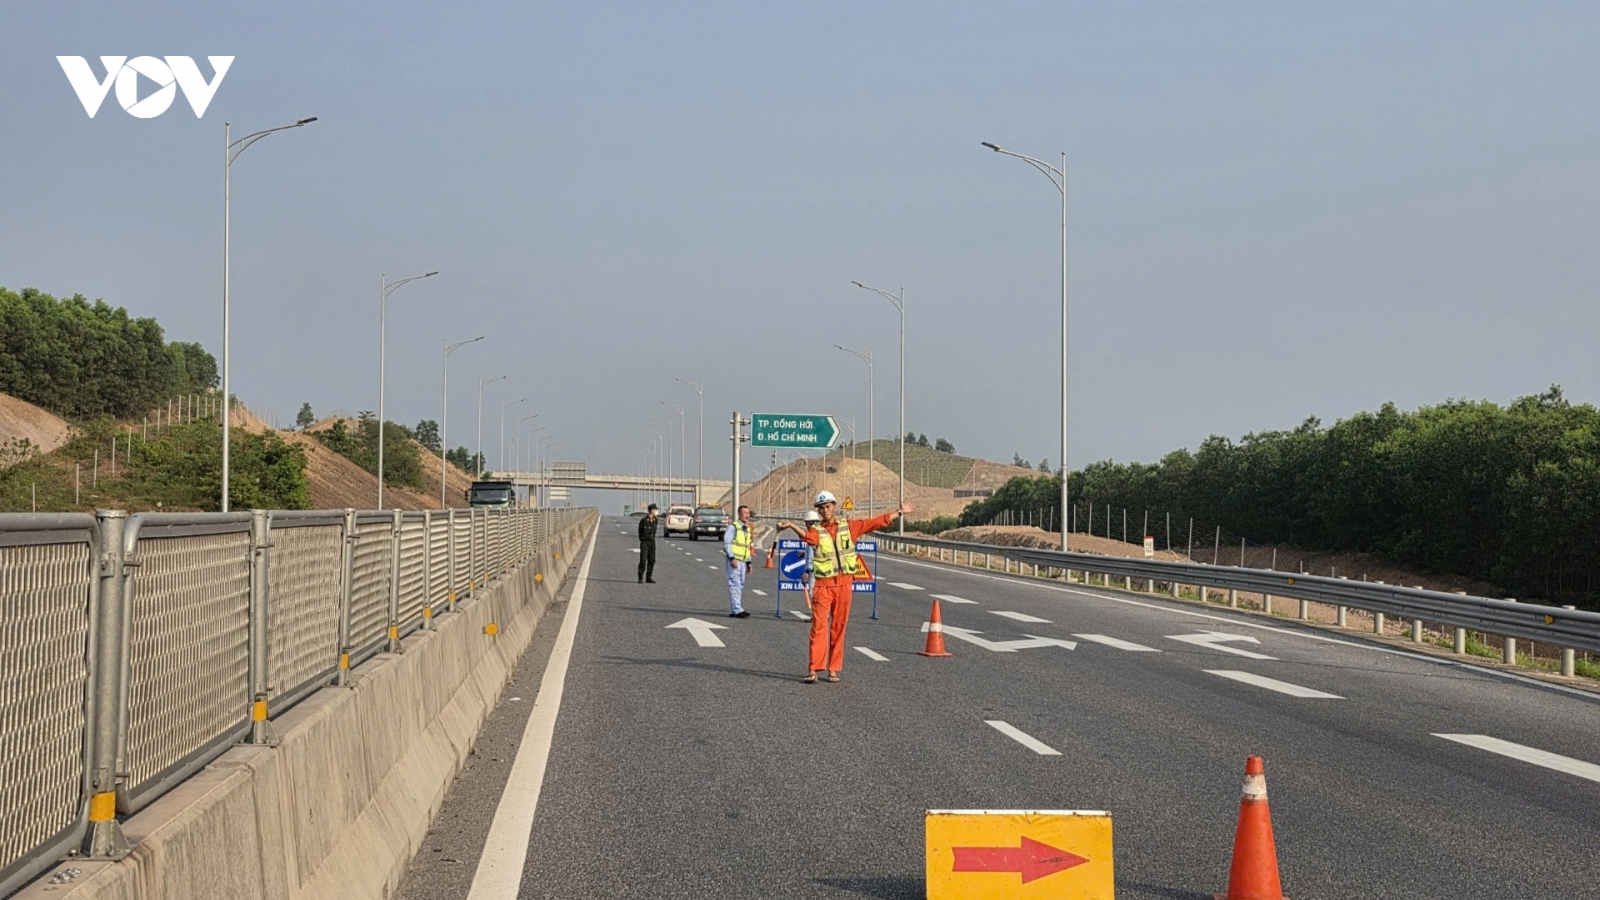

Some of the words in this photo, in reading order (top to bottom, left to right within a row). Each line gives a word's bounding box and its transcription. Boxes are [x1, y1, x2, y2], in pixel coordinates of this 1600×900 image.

[781, 431, 796, 442] CHÍ
[796, 433, 817, 443] MINH
[782, 539, 800, 548] CÔNG
[856, 542, 875, 550] CÔNG
[780, 582, 793, 590] XIN
[855, 583, 872, 591] NÀY!
